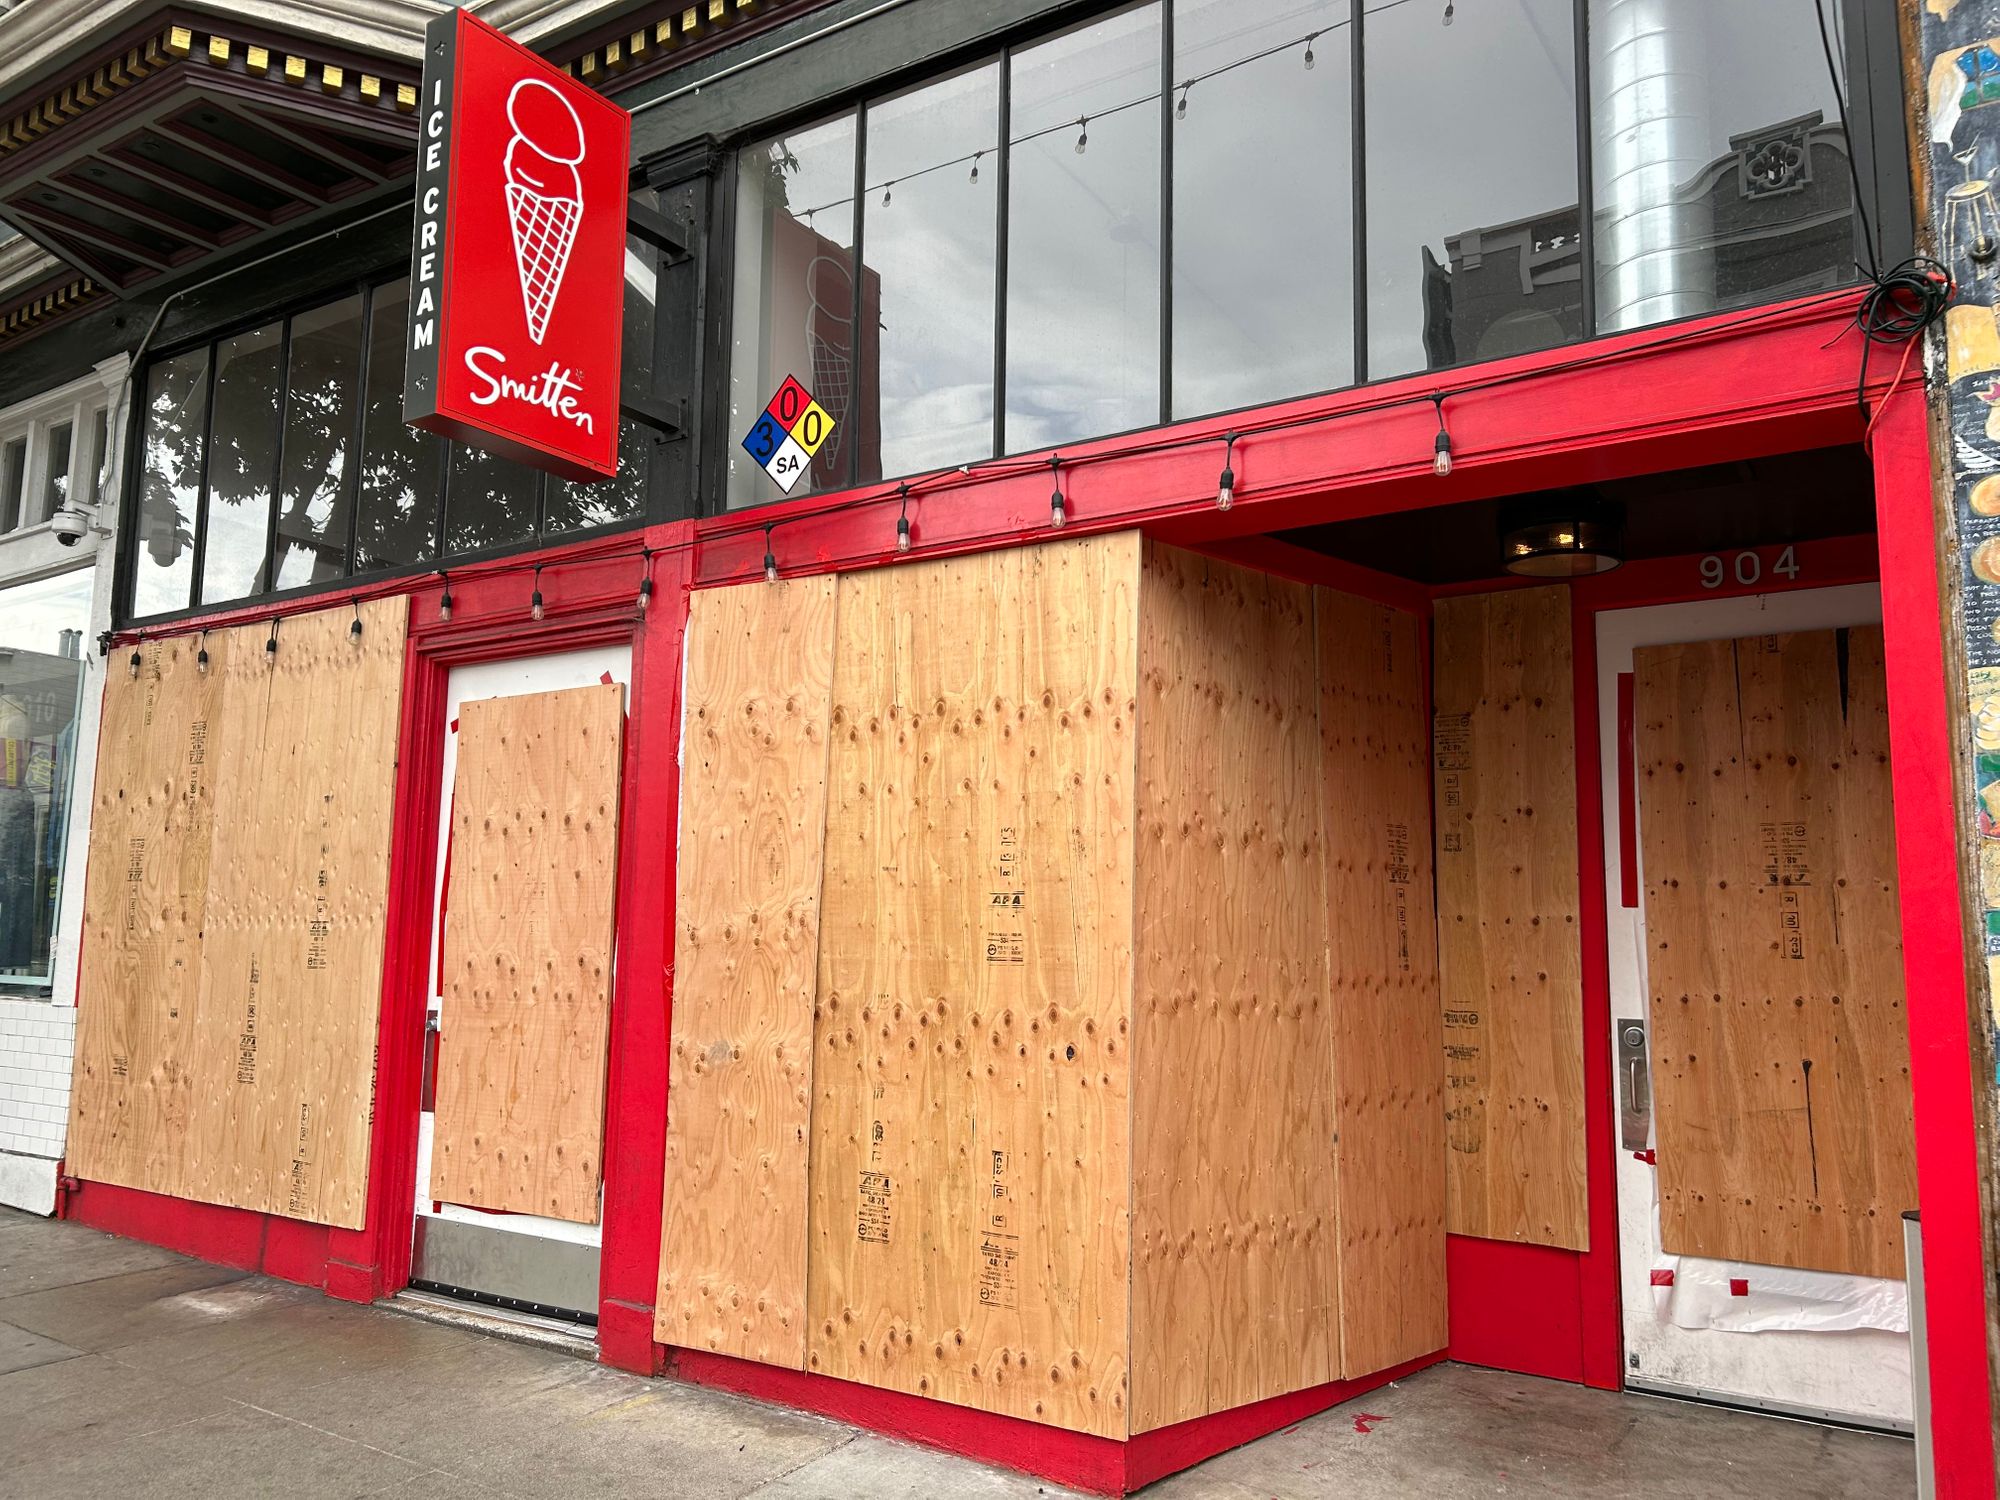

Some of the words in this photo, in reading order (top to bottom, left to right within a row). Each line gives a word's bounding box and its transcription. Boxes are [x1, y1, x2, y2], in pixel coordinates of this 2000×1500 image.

[425, 79, 443, 173] ICE
[414, 186, 439, 351] CREAM
[464, 345, 594, 435] Smitten
[779, 387, 798, 422] 0
[756, 421, 774, 457] 3
[803, 410, 822, 447] 0
[776, 454, 799, 474] SA
[1700, 545, 1800, 589] 904
